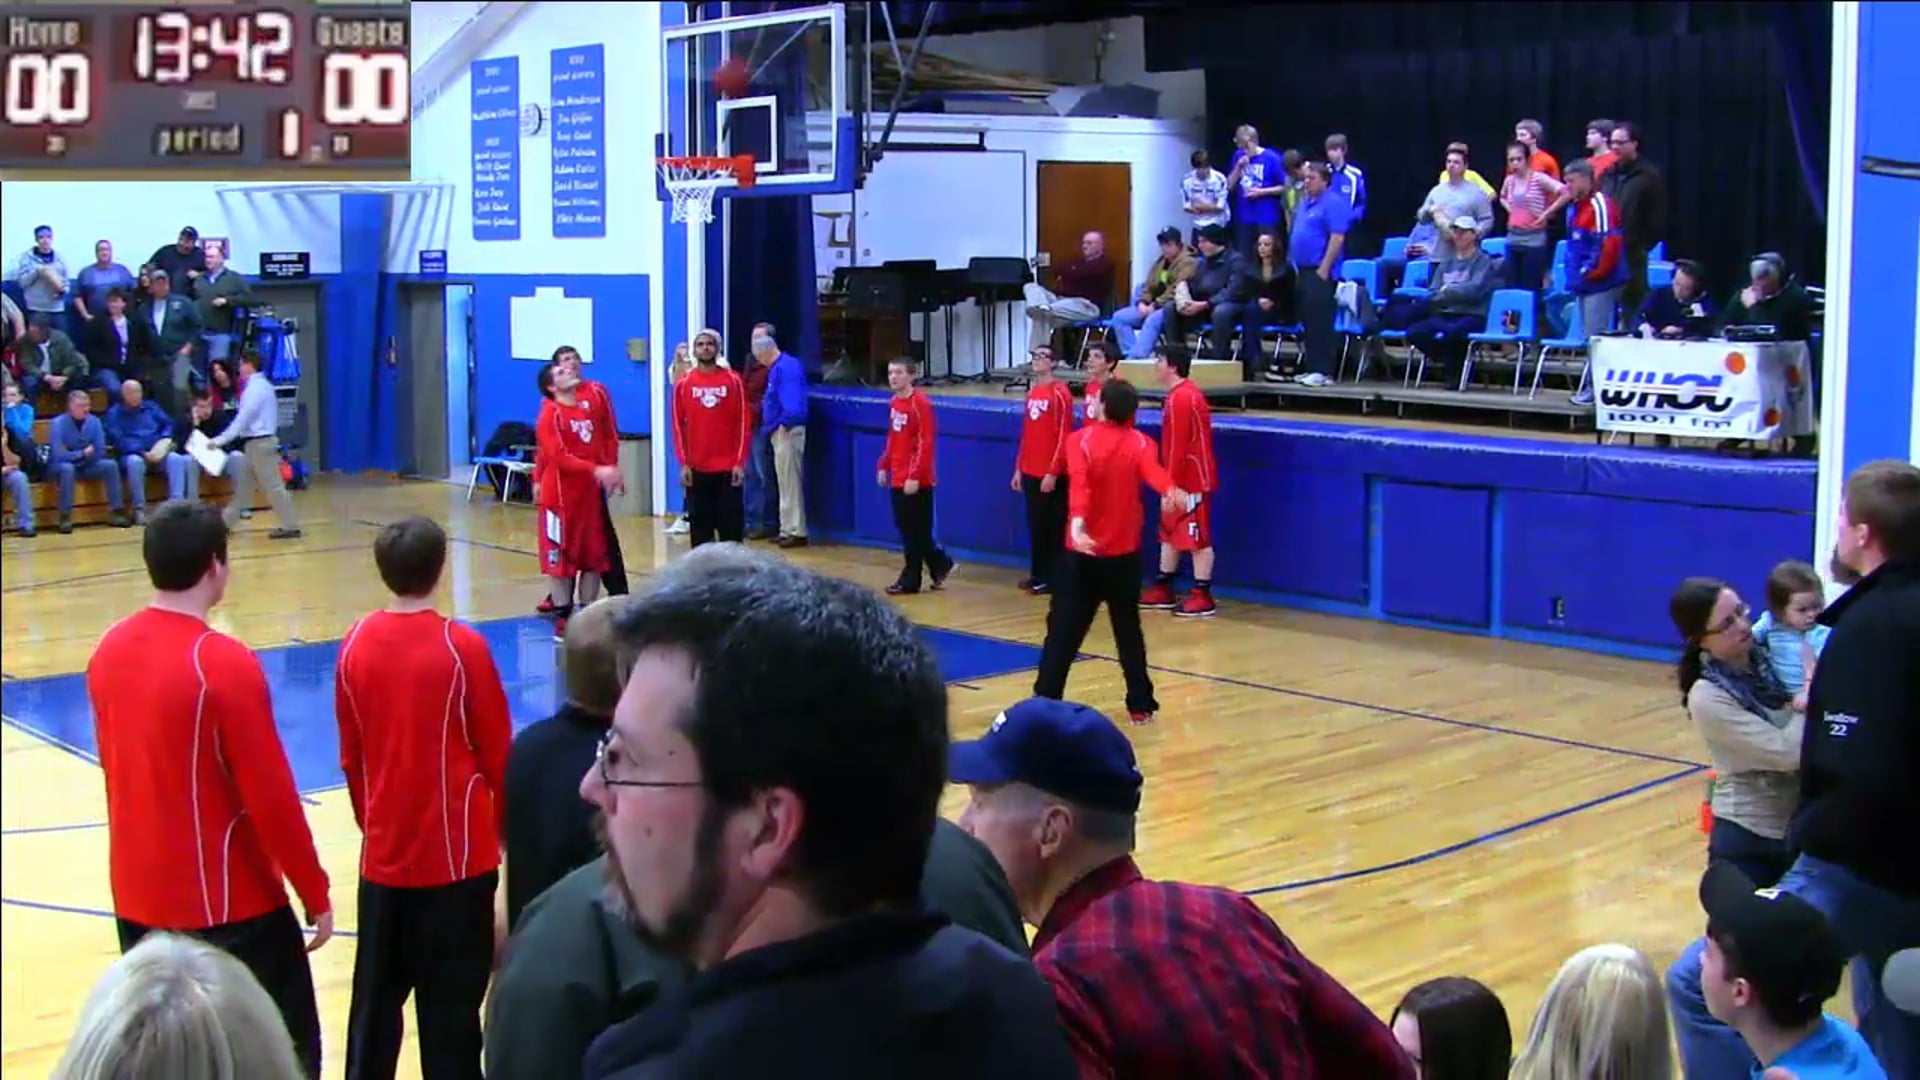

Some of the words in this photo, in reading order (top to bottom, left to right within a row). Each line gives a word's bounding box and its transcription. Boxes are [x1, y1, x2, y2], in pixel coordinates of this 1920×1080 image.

[1607, 413, 1675, 424] 100.1
[1691, 418, 1731, 429] fm
[1830, 724, 1848, 736] 22
